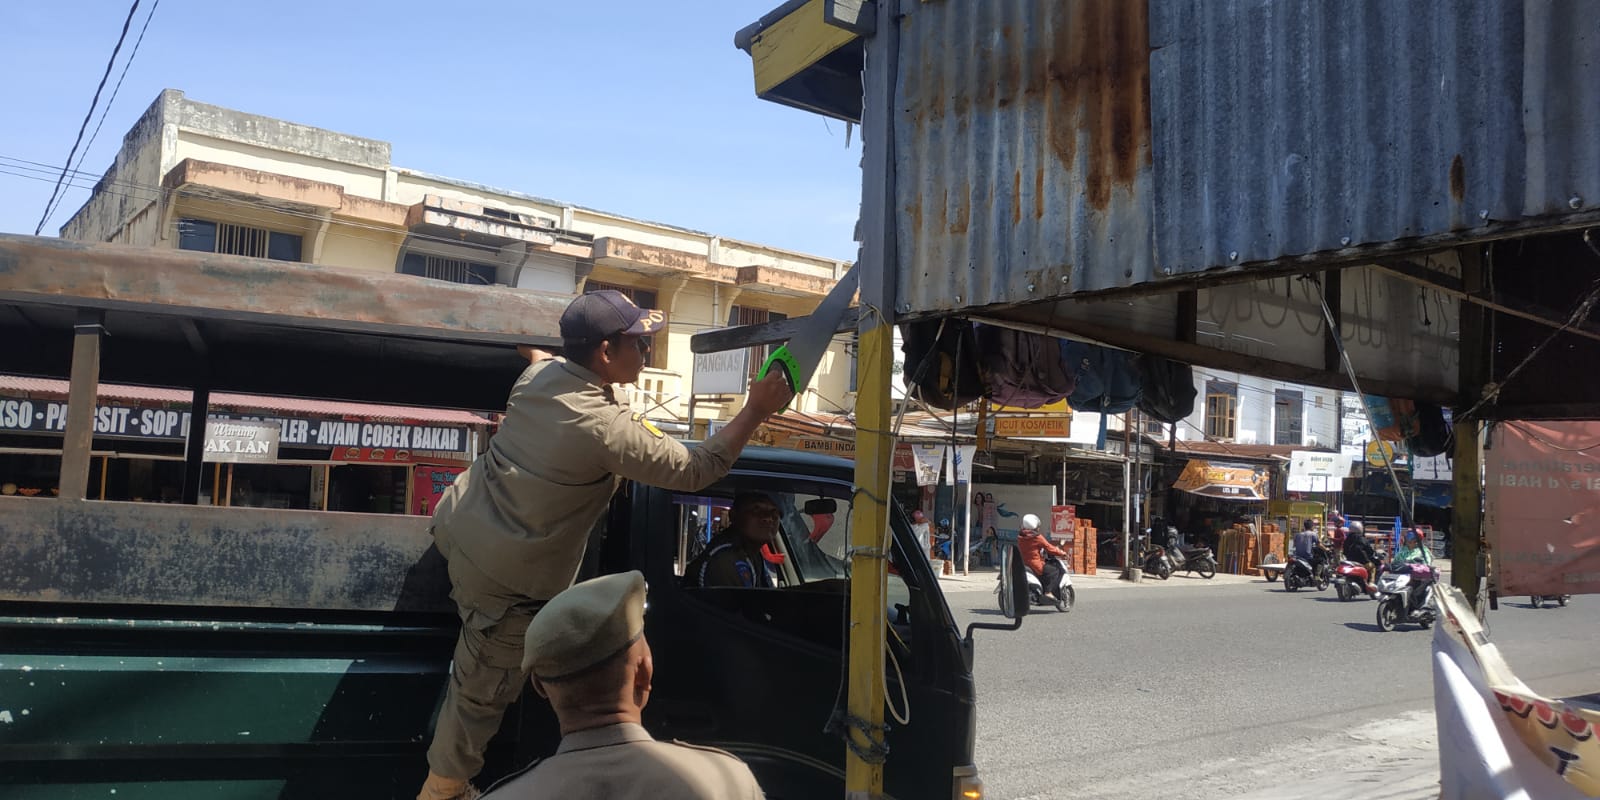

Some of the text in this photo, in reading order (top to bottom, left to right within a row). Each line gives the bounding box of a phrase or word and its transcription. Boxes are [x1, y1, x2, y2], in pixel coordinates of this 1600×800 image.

[696, 353, 742, 373] PANGKAS
[140, 409, 178, 436] SOP
[317, 421, 360, 446] AYAM
[361, 423, 411, 448] COBEK
[412, 426, 459, 450] BAKAR
[1020, 420, 1065, 430] KOSMETIK
[203, 439, 270, 454] AK LAN
[804, 440, 856, 452] BAMBI INDA
